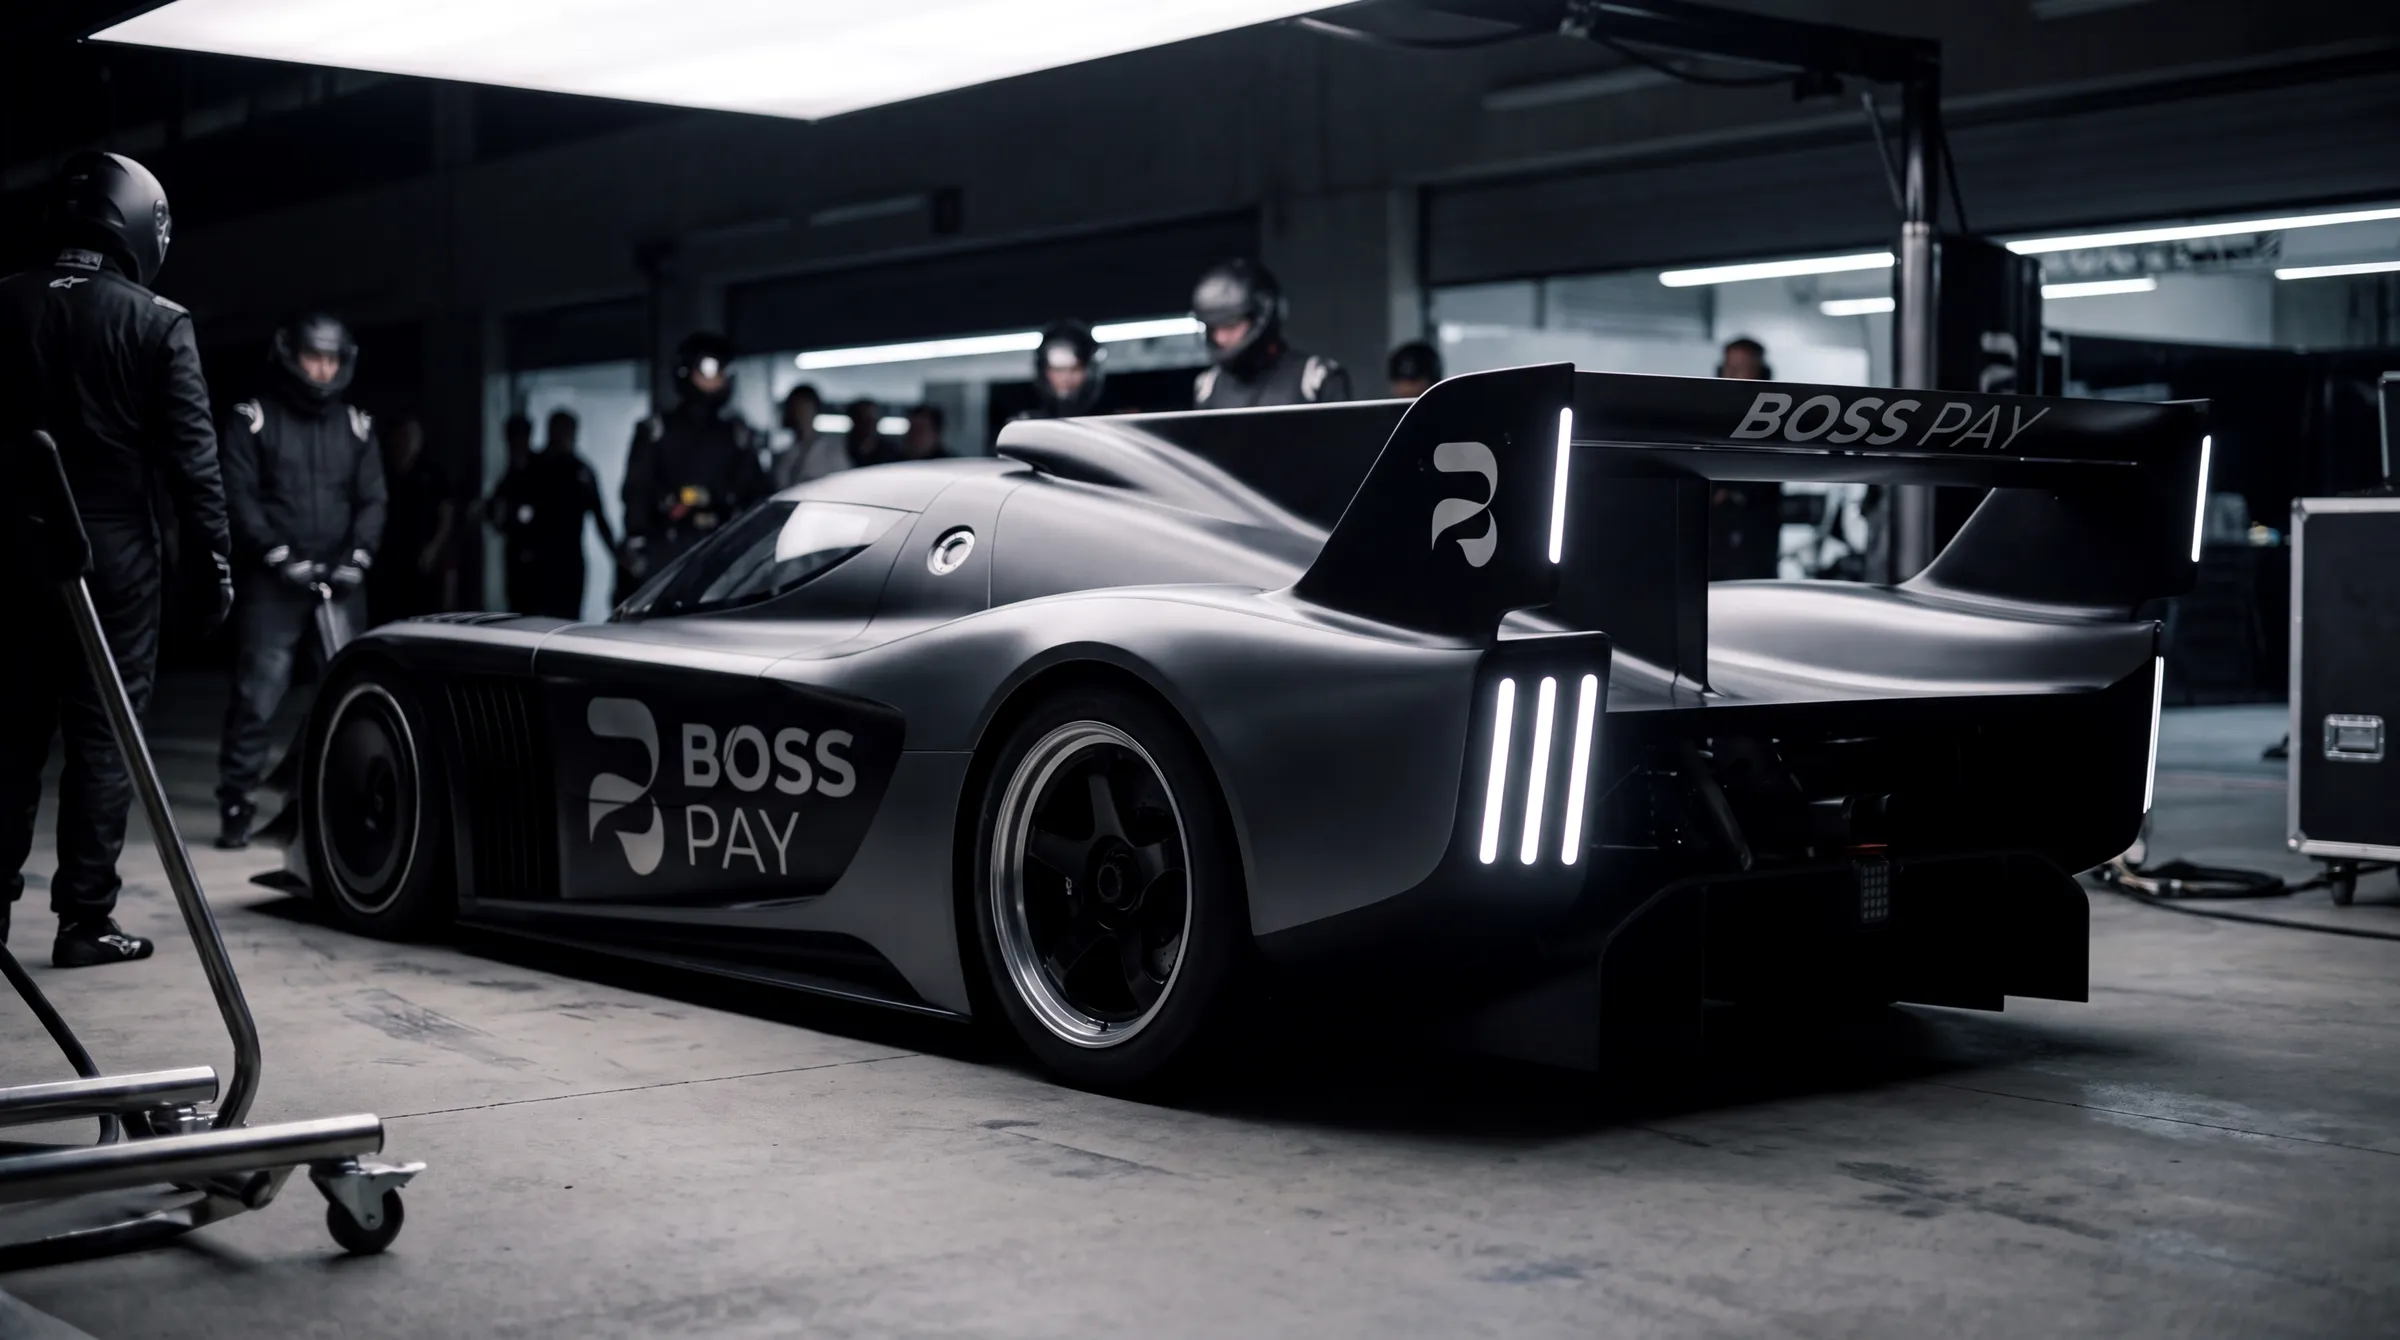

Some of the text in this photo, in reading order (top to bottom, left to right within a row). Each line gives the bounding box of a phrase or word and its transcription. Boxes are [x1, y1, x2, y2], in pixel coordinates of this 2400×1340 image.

[1730, 392, 2051, 450] BOSS PAY
[681, 721, 857, 798] BOSS
[685, 803, 800, 876] PAY
